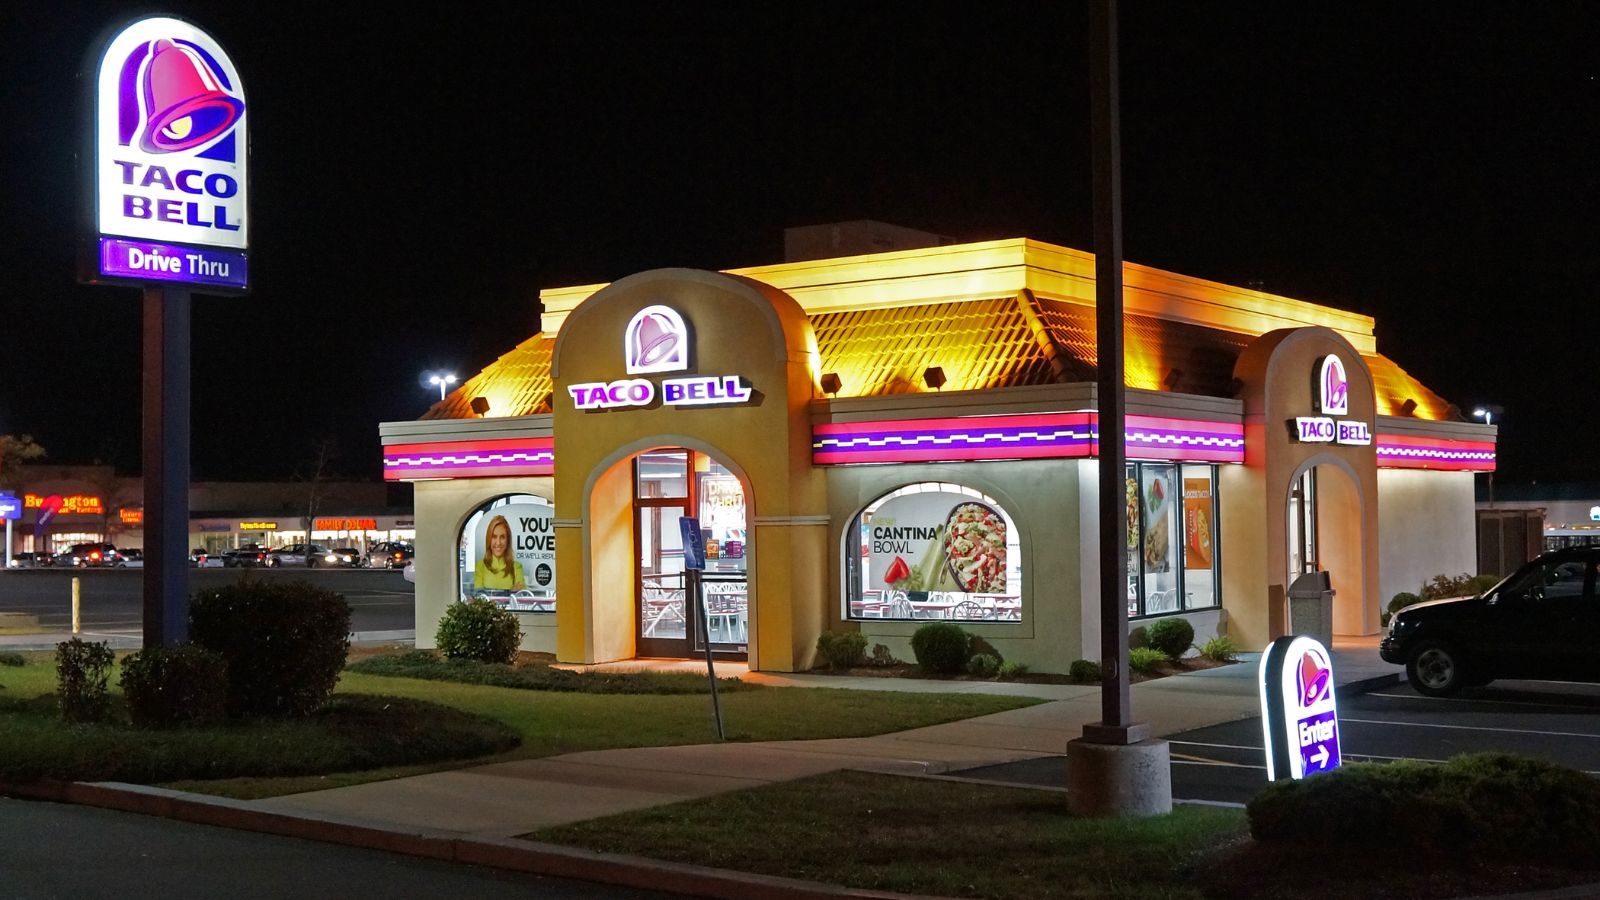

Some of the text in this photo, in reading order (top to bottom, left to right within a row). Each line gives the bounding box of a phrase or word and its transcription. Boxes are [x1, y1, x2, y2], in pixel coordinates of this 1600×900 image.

[113, 159, 238, 199] TACO
[122, 194, 241, 232] BELL
[128, 247, 229, 277] Drive Thru
[570, 379, 747, 406] TACO BELL
[1300, 420, 1370, 441] TACO BELL
[316, 518, 345, 531] FAMILY
[519, 517, 556, 534] YOU'
[873, 526, 938, 541] CANTINA
[516, 535, 556, 551] LOVE
[873, 540, 914, 554] BOWL
[1298, 720, 1335, 747] Enter
